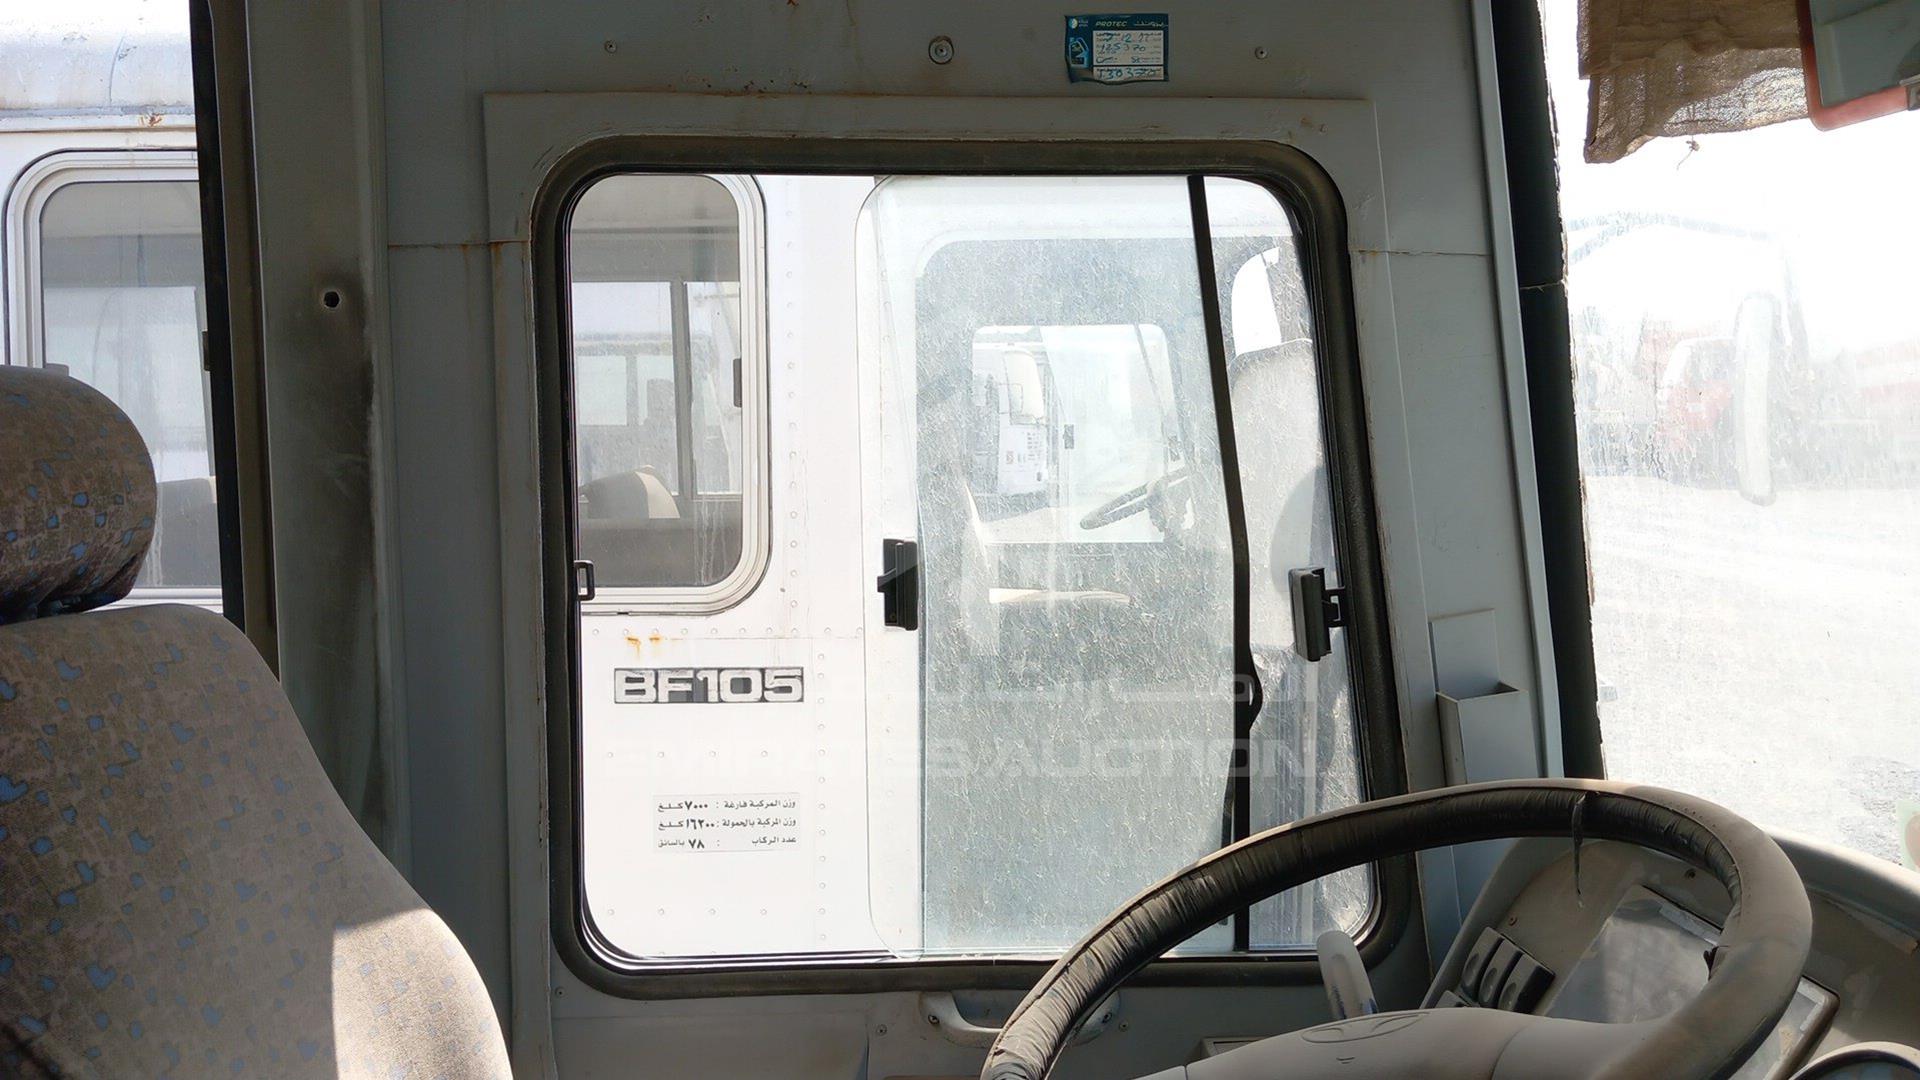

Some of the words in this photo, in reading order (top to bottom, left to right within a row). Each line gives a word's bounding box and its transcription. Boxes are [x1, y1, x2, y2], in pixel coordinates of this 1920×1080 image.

[614, 667, 804, 704] BF105
[724, 800, 748, 810] فارغة
[749, 799, 781, 810] المركبة
[783, 799, 796, 808] وزن
[722, 818, 755, 828] بالحمولة
[757, 818, 781, 827] المركبة
[783, 817, 797, 826] وزن
[688, 838, 705, 849] ٧٨
[752, 836, 779, 845] الركاب
